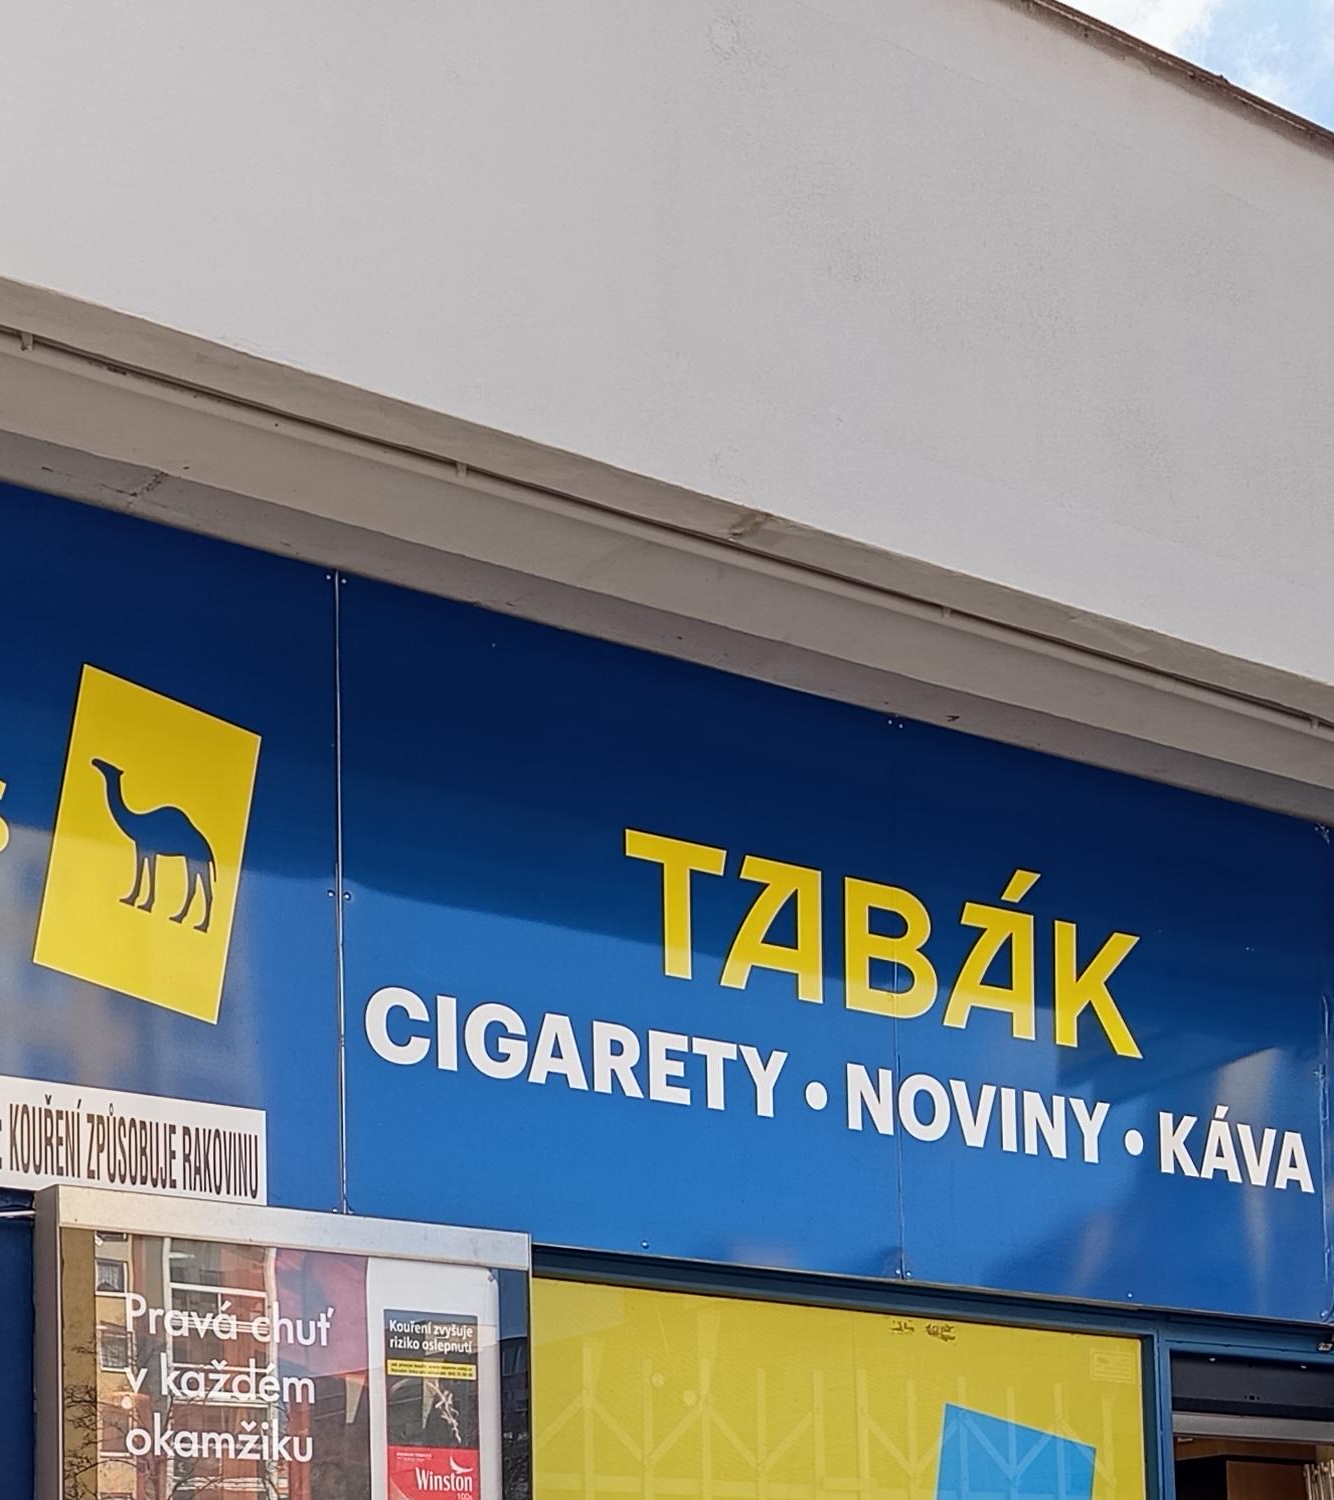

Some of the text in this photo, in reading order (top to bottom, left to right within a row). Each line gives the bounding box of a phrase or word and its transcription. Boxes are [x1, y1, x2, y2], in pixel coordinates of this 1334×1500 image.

[624, 828, 1143, 1060] TABÁK
[364, 986, 1316, 1194] CIGARETY NOVINY KÁVA
[9, 1094, 83, 1179] KOUŘENÍ
[86, 1102, 178, 1190] ZPŮSOBUJE
[182, 1124, 260, 1200] RAKOVINU
[125, 1292, 335, 1347] Pravá chuť
[389, 1319, 473, 1340] Kouření zvyšuje
[389, 1336, 473, 1355] riziko oslepnutí
[125, 1352, 316, 1405] v každém
[125, 1412, 314, 1463] okamžiku
[415, 1467, 473, 1492] Winston
